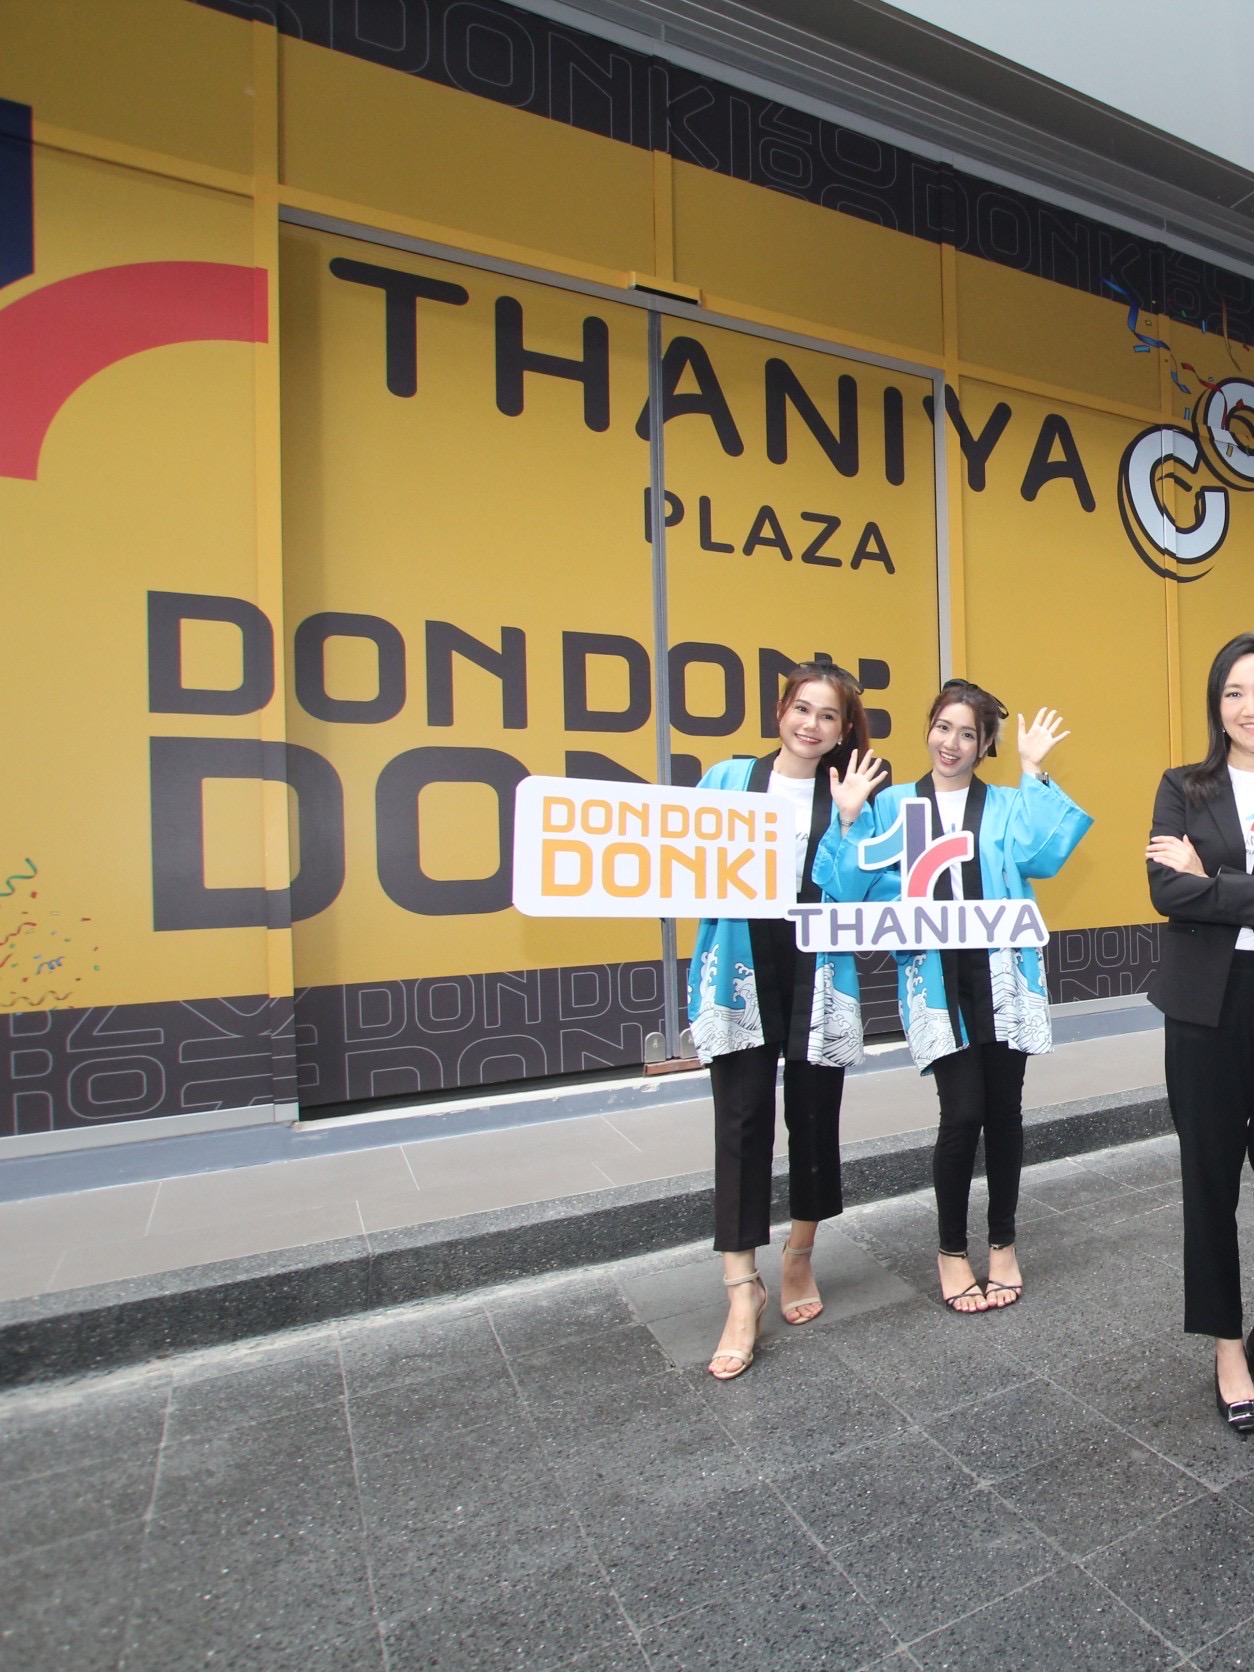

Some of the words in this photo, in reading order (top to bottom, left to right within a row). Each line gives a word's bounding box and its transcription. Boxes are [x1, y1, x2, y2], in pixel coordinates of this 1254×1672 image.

[912, 163, 1166, 313] DONKI
[331, 257, 1097, 513] THANIYA
[644, 486, 896, 575] PLAZA
[147, 590, 527, 730] DON
[542, 796, 649, 837] DON
[541, 838, 778, 900] DONKI
[787, 904, 1045, 948] THANIYA
[344, 970, 541, 1043] DON
